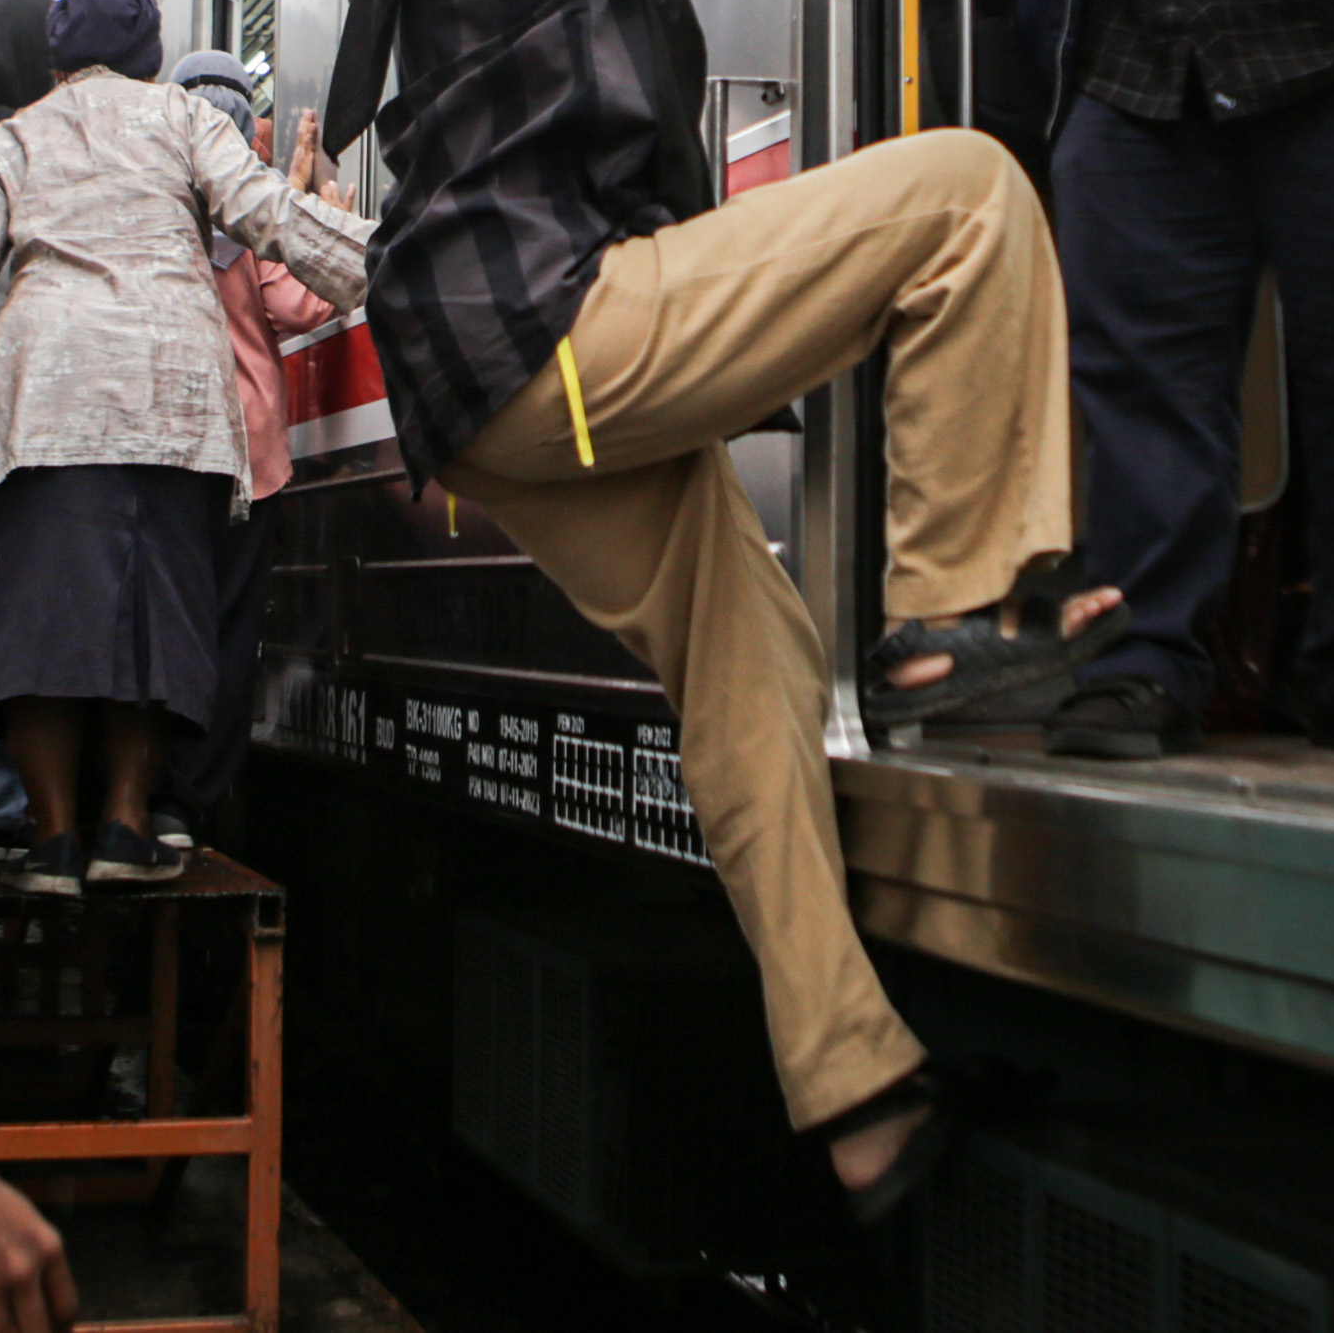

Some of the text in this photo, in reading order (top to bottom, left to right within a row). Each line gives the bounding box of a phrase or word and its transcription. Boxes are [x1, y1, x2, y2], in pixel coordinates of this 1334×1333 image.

[340, 687, 366, 764] 161
[376, 716, 395, 750] BUD
[406, 698, 462, 741] BK-31100KG
[499, 714, 539, 745] 19-05-2019
[498, 748, 538, 778] 07-11-2021
